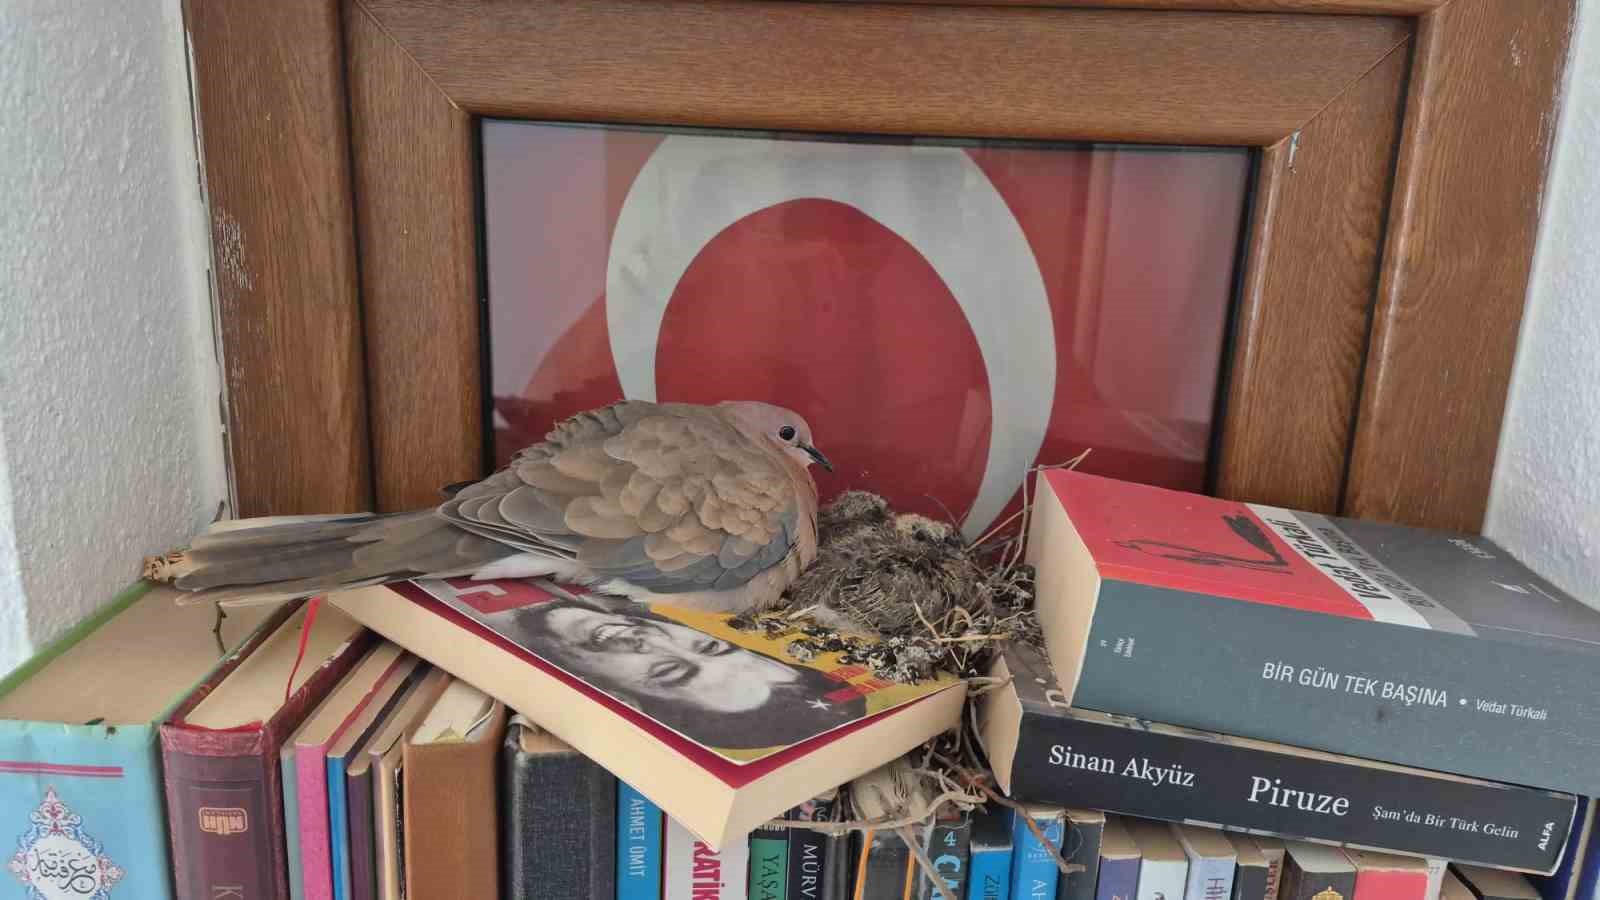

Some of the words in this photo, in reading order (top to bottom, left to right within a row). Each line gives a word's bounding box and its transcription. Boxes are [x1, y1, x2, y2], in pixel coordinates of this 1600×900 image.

[1262, 660, 1294, 683] BİR
[1298, 665, 1340, 690] GÜN
[1344, 675, 1379, 697] TEK
[1381, 681, 1448, 708] BAŞINA
[1476, 698, 1507, 714] Vedat
[1510, 703, 1548, 721] Türkali
[1049, 744, 1116, 774] Sinan
[1121, 757, 1195, 787] Akyüz
[1247, 776, 1350, 816] Piruze
[629, 798, 646, 841] AHMET
[1424, 814, 1447, 828] Bir
[1449, 817, 1480, 833] Türk
[1483, 823, 1520, 840] Gelin
[1537, 821, 1556, 852] ALFA
[943, 831, 957, 848] 4
